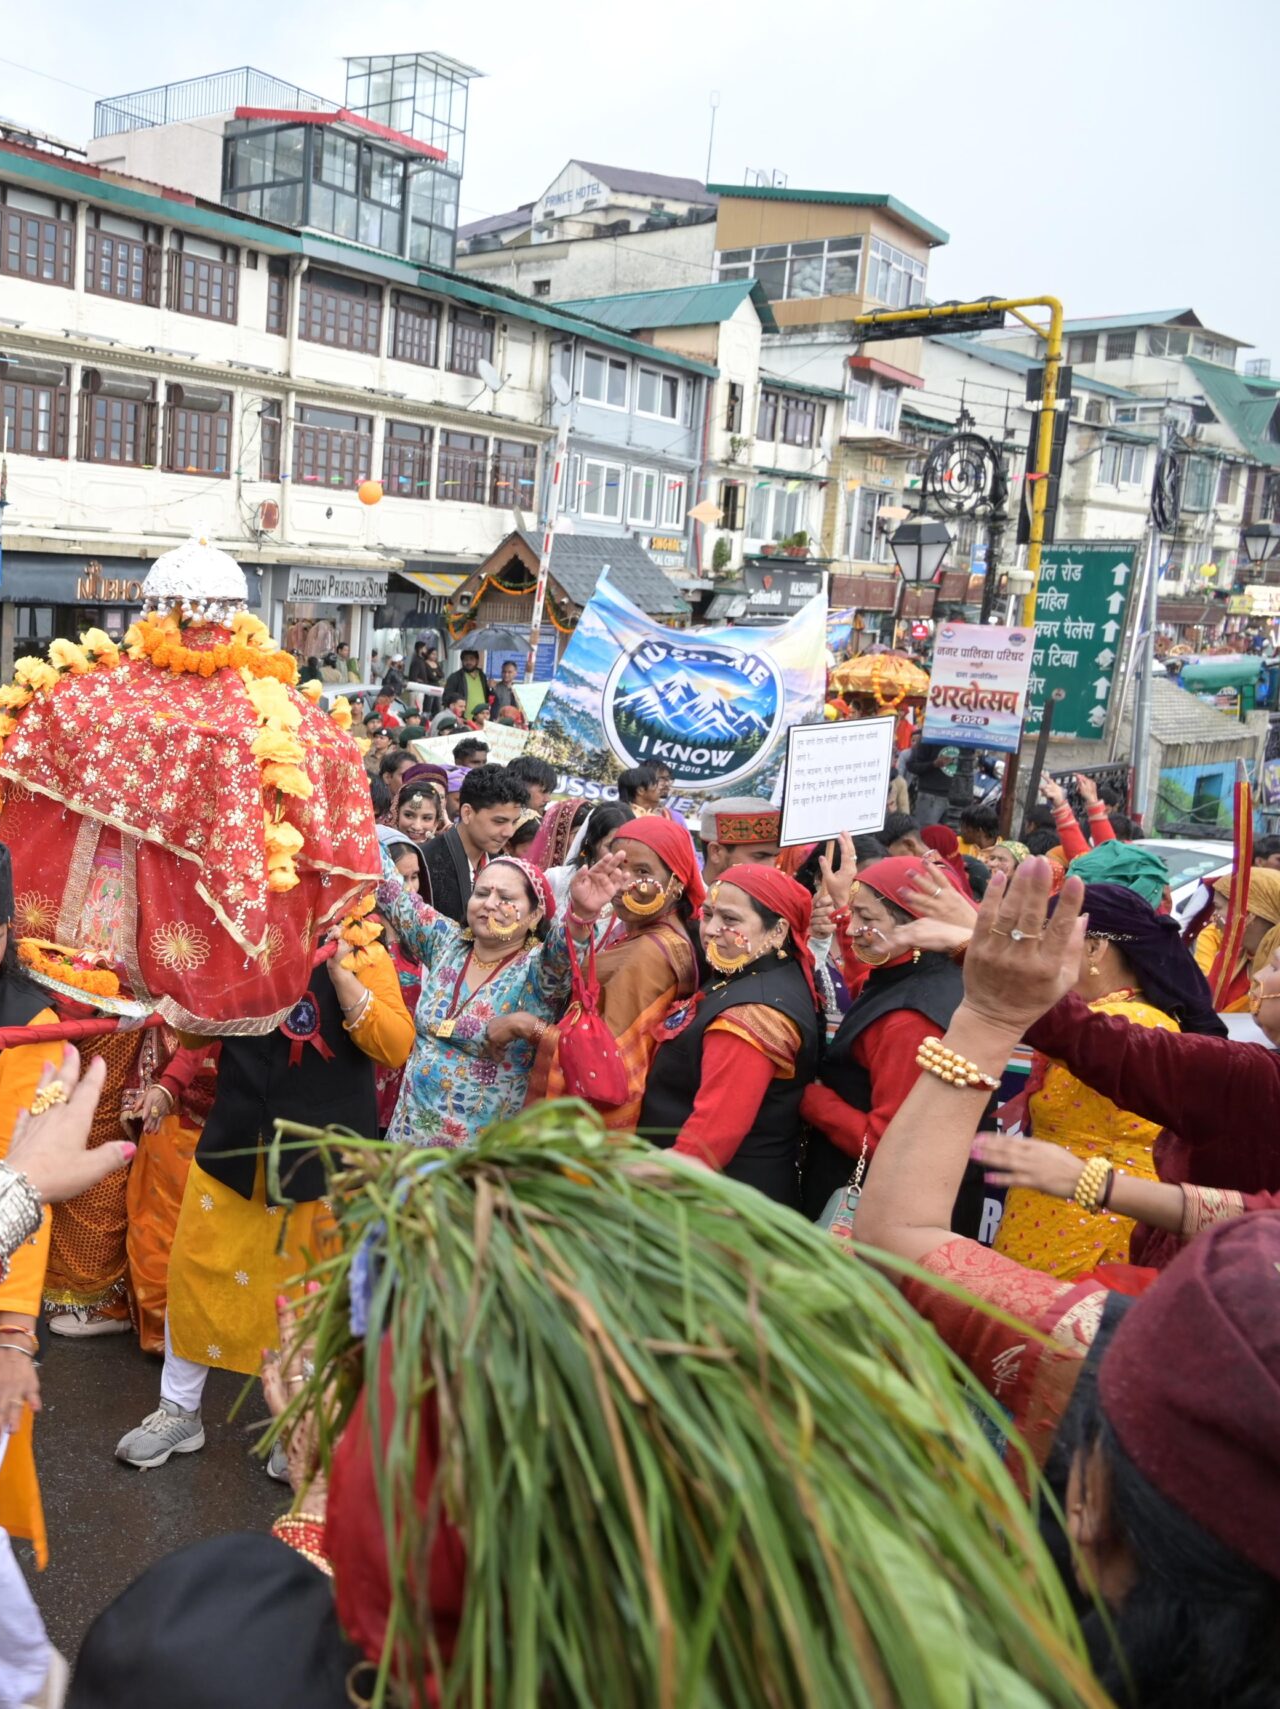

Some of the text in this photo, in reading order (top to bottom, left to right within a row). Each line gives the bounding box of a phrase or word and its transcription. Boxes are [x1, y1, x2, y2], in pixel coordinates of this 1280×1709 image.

[575, 183, 601, 199] HOTEL
[1061, 557, 1084, 582] रोड
[293, 574, 388, 599] JAGDISH PRASAD & SONS
[1036, 586, 1069, 612] नहिल
[1034, 615, 1096, 640] क्चर पैलेस
[937, 646, 958, 658] नगर
[960, 644, 994, 660] पालिका
[1032, 649, 1045, 667] ल
[930, 680, 1019, 715] शरदोत्सव
[638, 735, 736, 767] I KNOW
[679, 764, 701, 774] 2018
